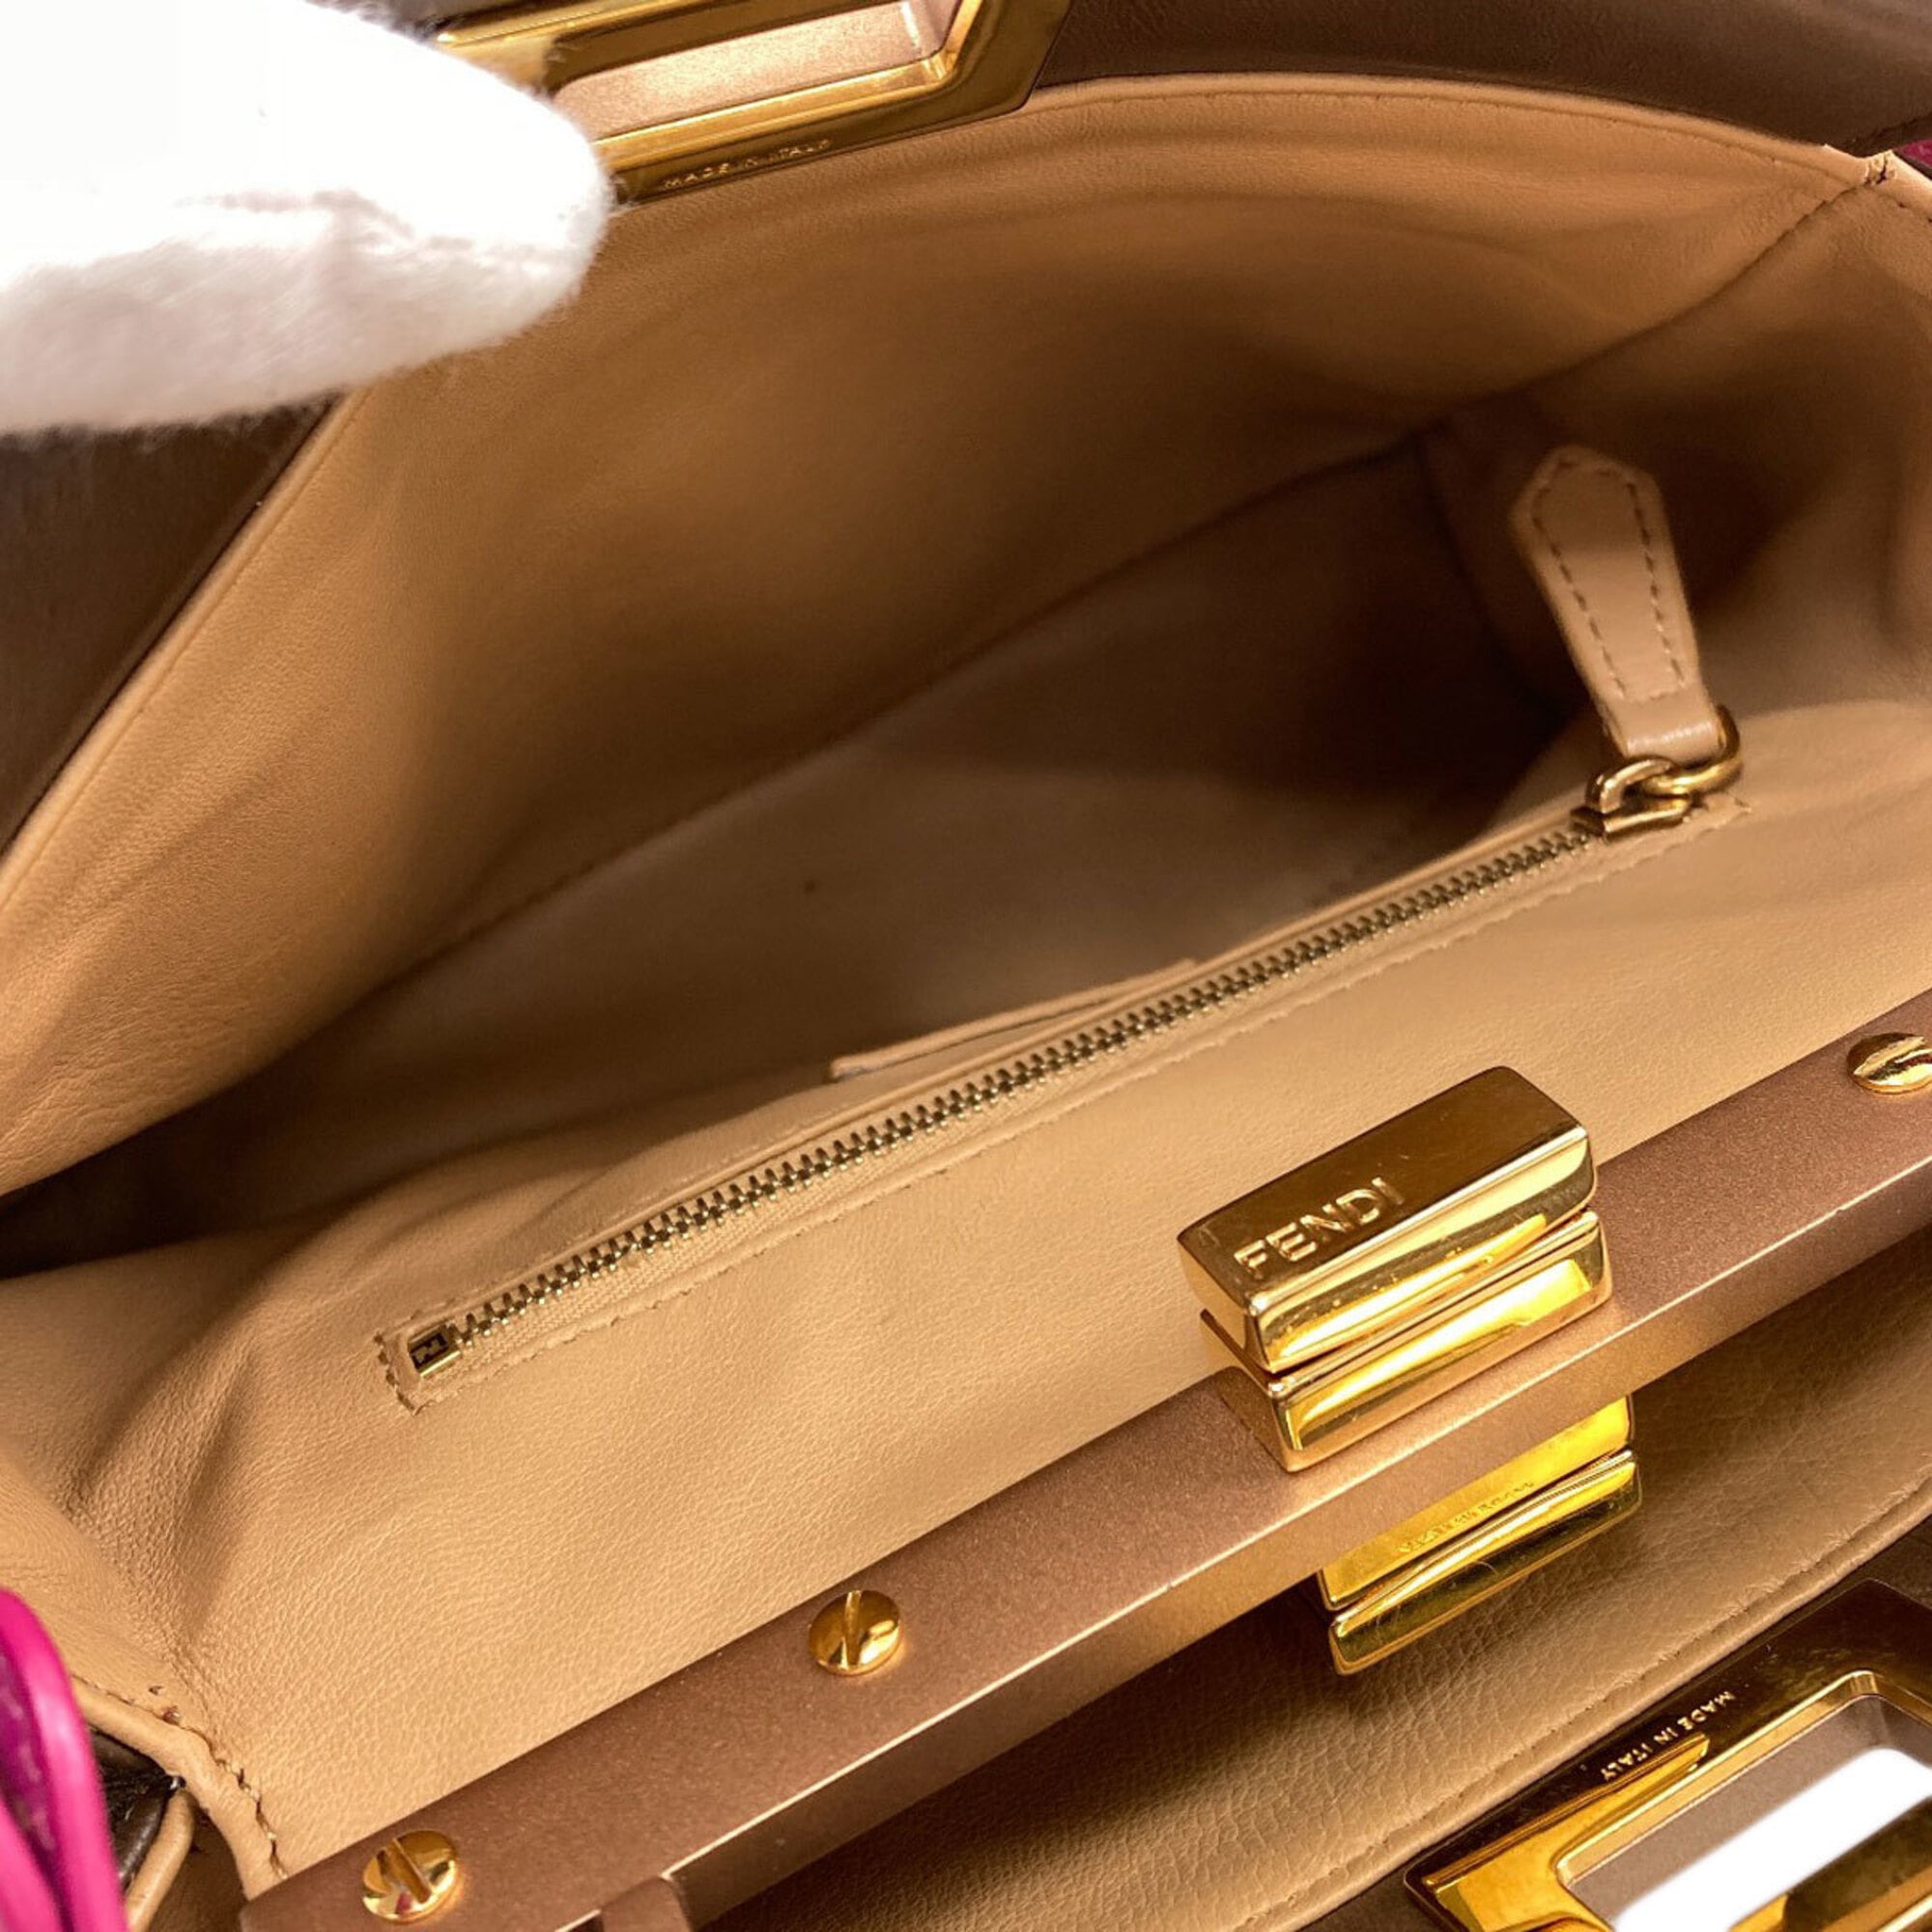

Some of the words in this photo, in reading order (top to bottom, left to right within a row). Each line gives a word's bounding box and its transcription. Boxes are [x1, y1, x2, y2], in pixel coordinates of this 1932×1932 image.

[664, 161, 731, 189] MADE
[1234, 1177, 1405, 1280] FENDI
[1677, 1690, 1736, 1731] MADE
[1653, 1726, 1679, 1746] IN
[1601, 1743, 1654, 1781] ITALY
